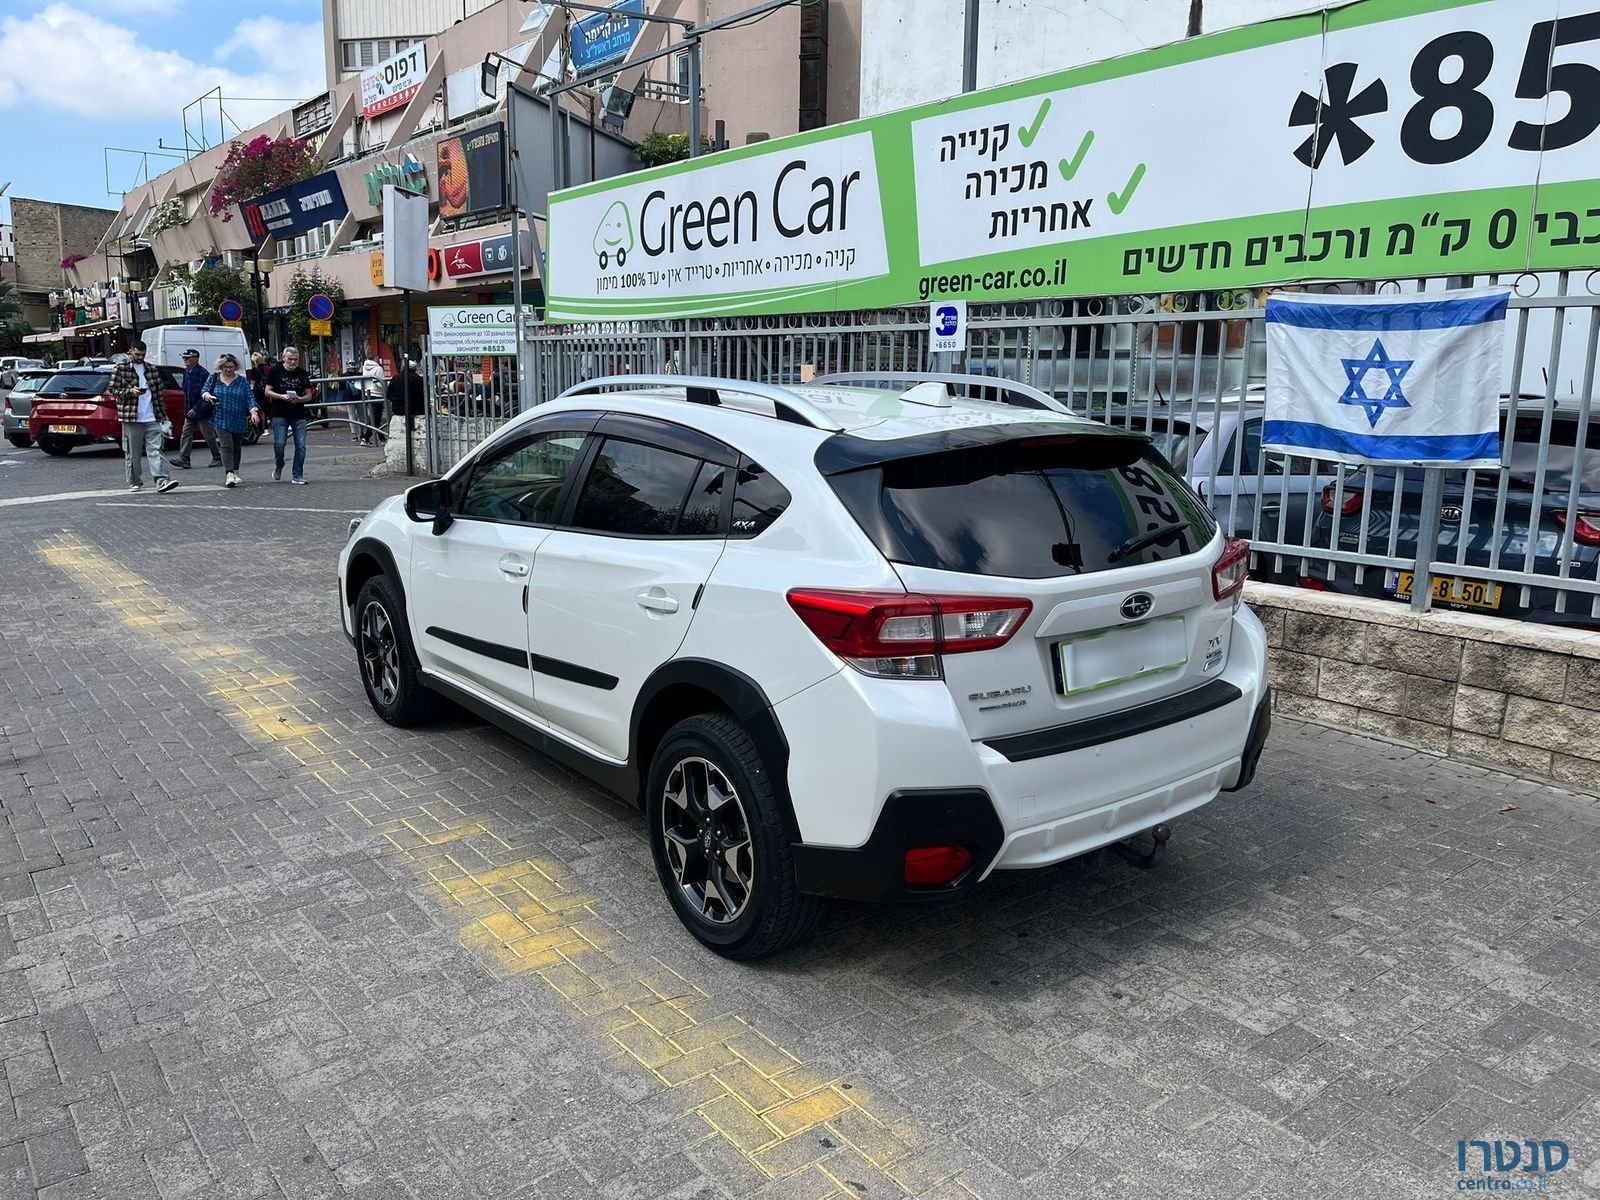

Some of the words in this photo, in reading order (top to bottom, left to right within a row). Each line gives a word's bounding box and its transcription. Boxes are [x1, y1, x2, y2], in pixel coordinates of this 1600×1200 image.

[585, 22, 611, 44] קדימה
[614, 16, 629, 32] בת
[612, 31, 631, 48] מרחב
[385, 52, 416, 85] דפוס
[940, 123, 1010, 162] קנייה
[965, 160, 1048, 200] מכירה
[640, 189, 758, 257] Green
[772, 160, 860, 238] Car
[988, 198, 1094, 239] אחריות
[1386, 211, 1471, 257] ק"מ
[1488, 208, 1517, 250] 0
[1244, 226, 1370, 267] ורכבים
[722, 257, 763, 278] אחריות
[774, 252, 812, 273] מכירה
[825, 248, 856, 272] קניה
[1122, 240, 1231, 276] חדשים
[620, 271, 646, 289] 100%
[647, 269, 660, 286] עד
[668, 266, 682, 288] אין
[684, 263, 712, 281] טרייד
[918, 258, 1067, 300] green-car.co.il
[596, 274, 618, 295] מימון
[457, 310, 493, 324] Green
[968, 684, 1032, 701] SUBARU
